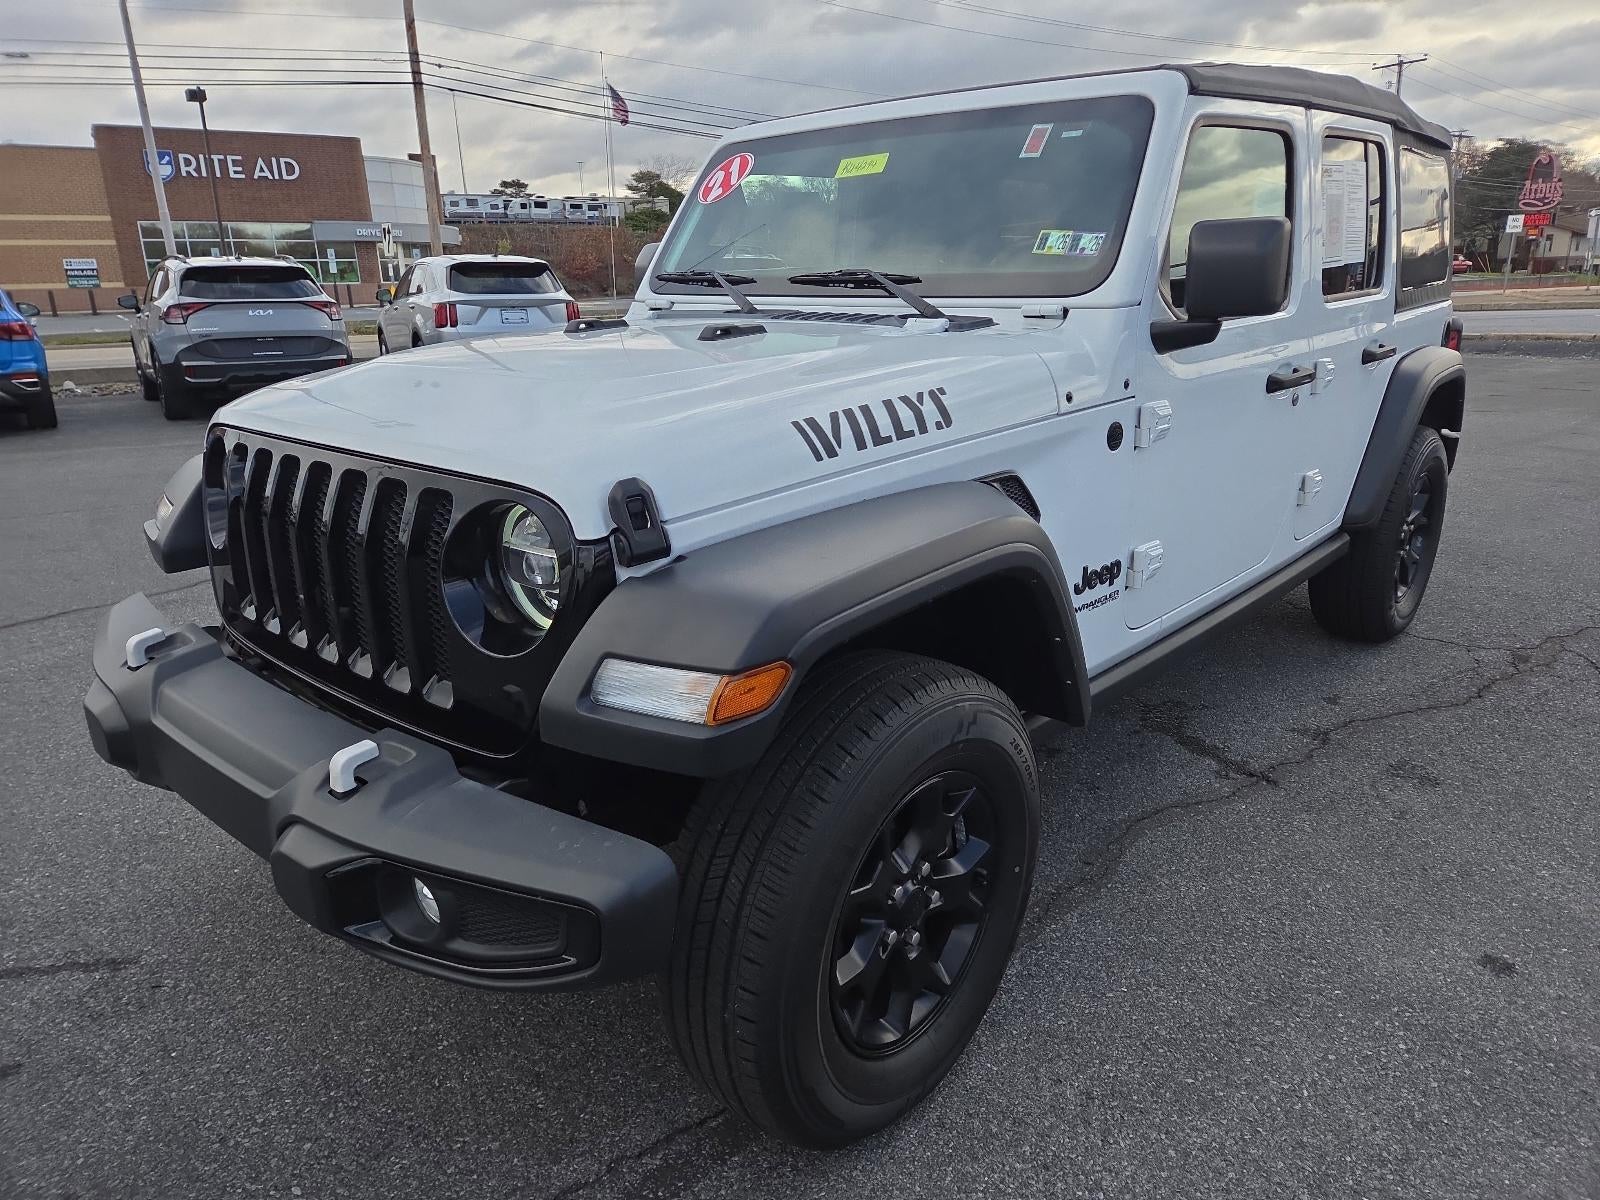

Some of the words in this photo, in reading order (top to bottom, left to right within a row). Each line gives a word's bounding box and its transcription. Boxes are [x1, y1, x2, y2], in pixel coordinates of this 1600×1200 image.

[178, 153, 246, 179] RITE
[253, 156, 300, 180] AID
[706, 156, 741, 202] 21
[1519, 178, 1563, 202] Arby's
[356, 228, 381, 237] DRIVE
[790, 386, 953, 462] WILLYS
[1073, 558, 1122, 596] Jeep
[1074, 589, 1120, 614] WRANGLER
